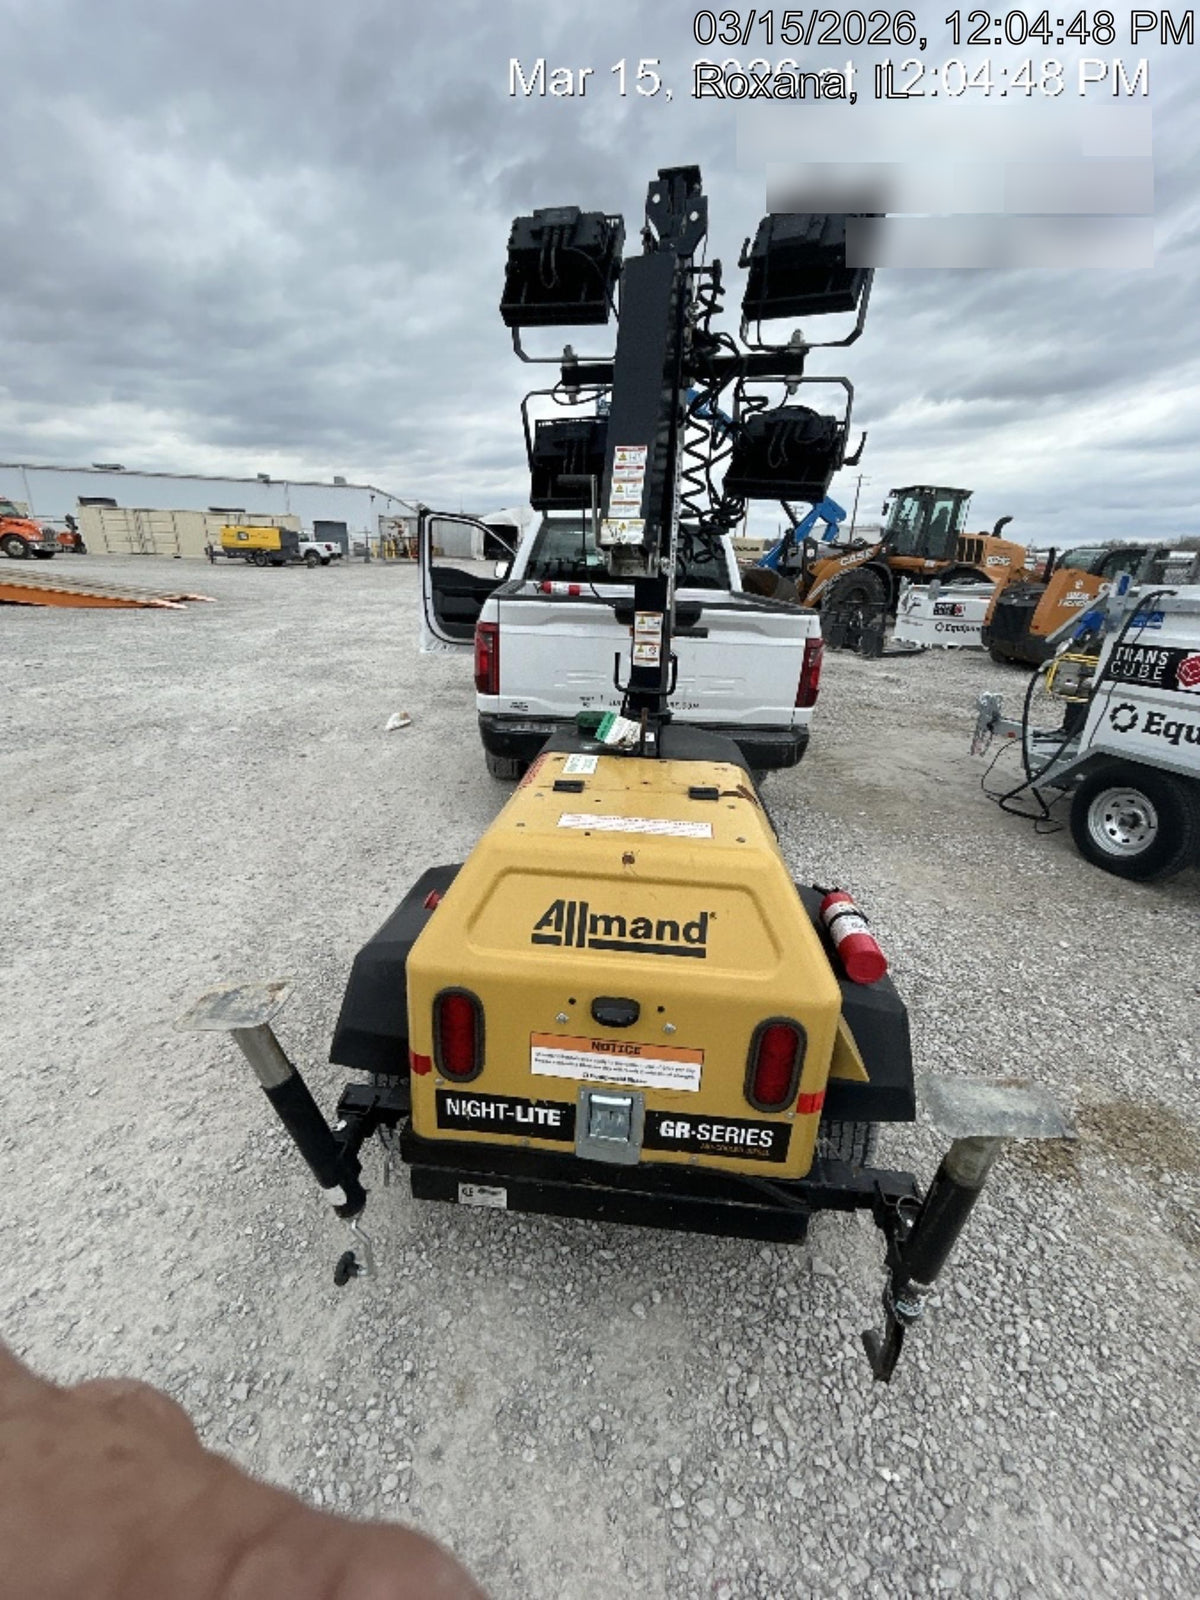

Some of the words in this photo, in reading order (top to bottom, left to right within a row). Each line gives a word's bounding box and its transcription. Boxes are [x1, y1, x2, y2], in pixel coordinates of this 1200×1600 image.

[1115, 646, 1169, 666] TRANS
[1110, 661, 1166, 680] CUBE
[532, 899, 709, 948] Allmand
[591, 1041, 642, 1056] NOTICE
[445, 1097, 561, 1127] NIGHT-LITE
